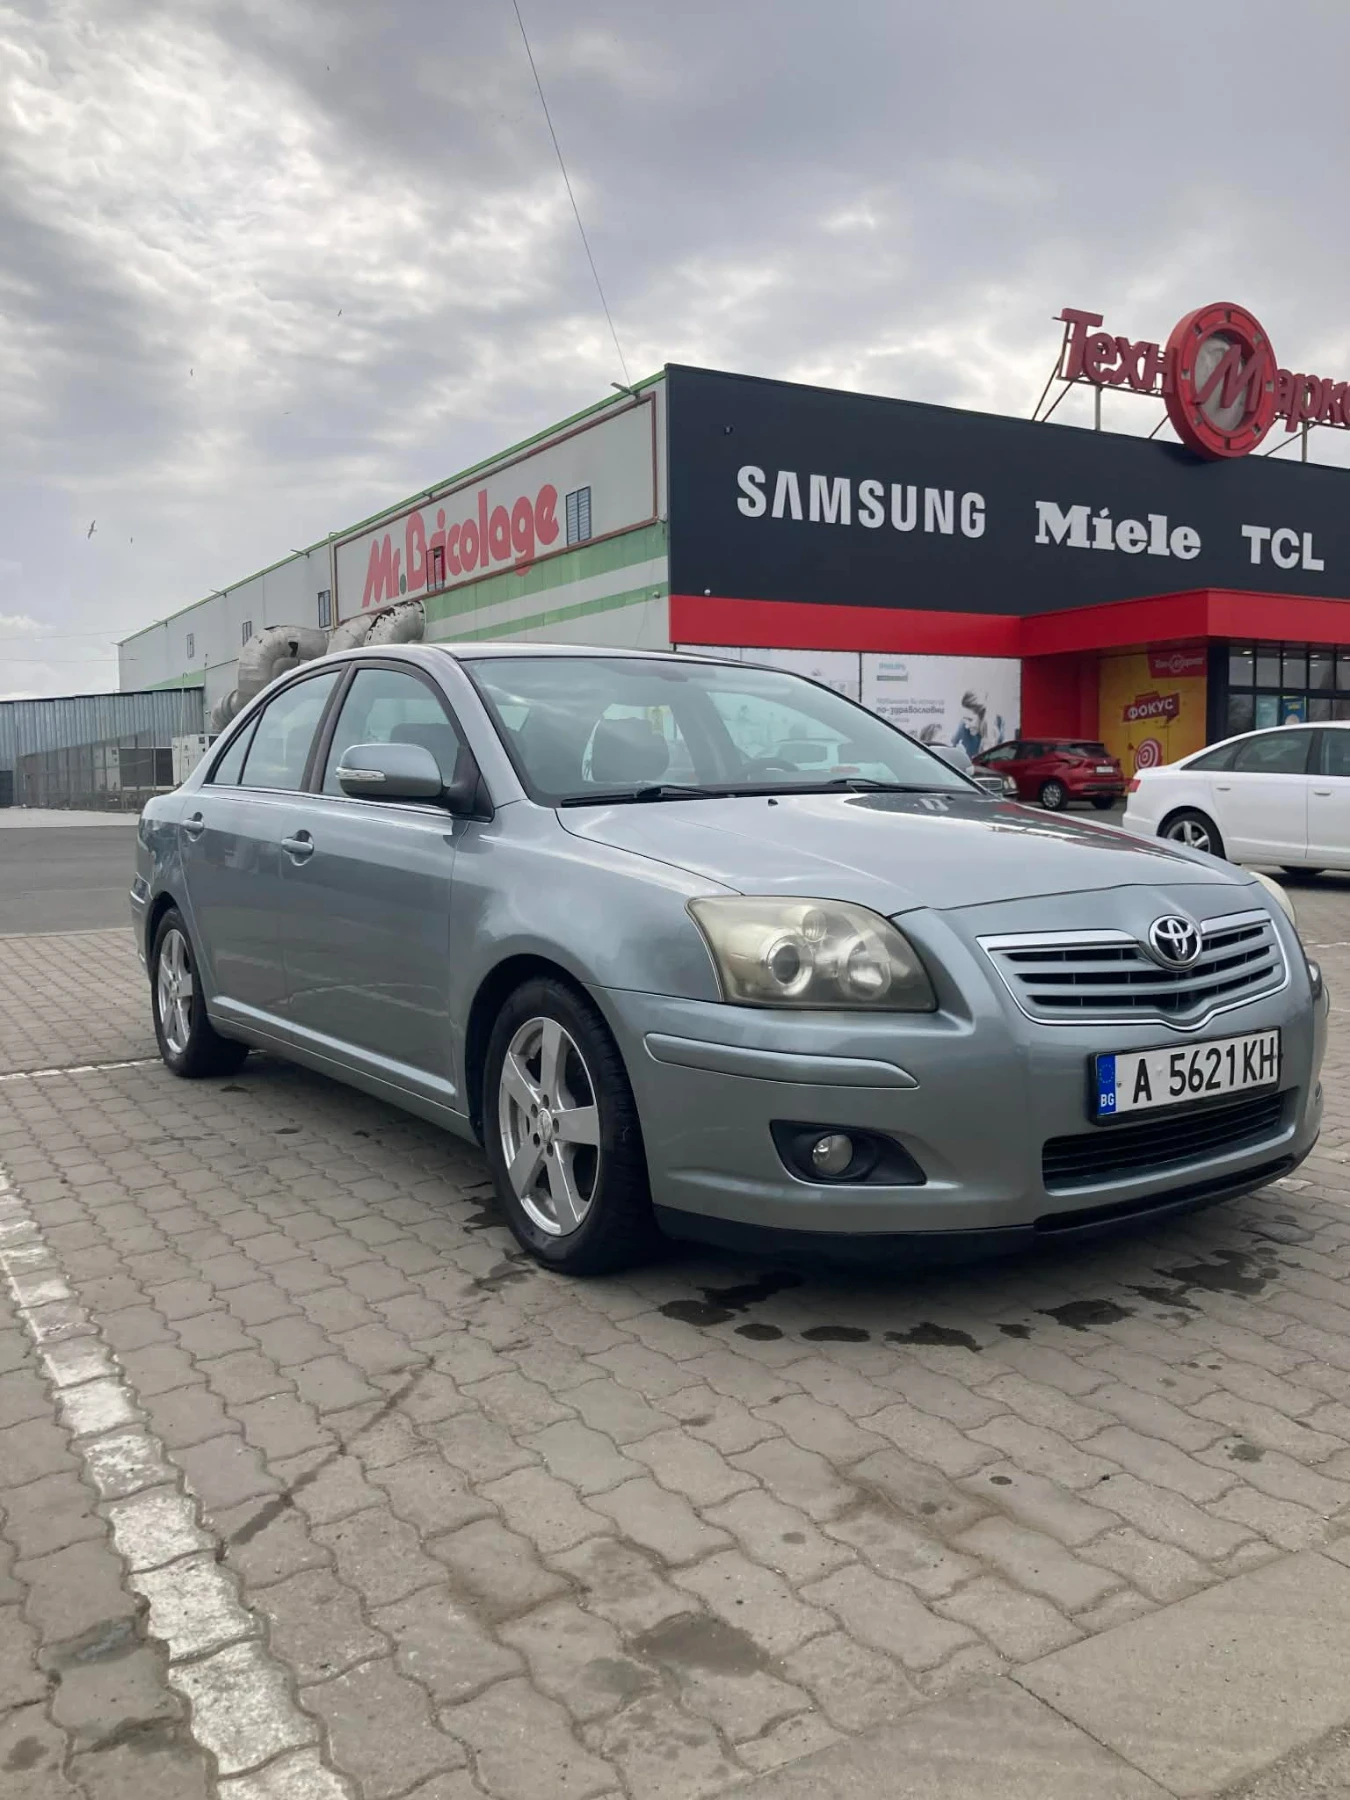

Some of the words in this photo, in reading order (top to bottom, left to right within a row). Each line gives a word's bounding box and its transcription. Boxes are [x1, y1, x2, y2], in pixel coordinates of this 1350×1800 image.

[736, 464, 987, 539] SAMSUNG
[1034, 499, 1201, 560] Miele
[1241, 524, 1325, 571] TCL
[1128, 698, 1174, 719] ФОКУС
[1100, 1093, 1115, 1108] BG
[1132, 1058, 1152, 1104] A
